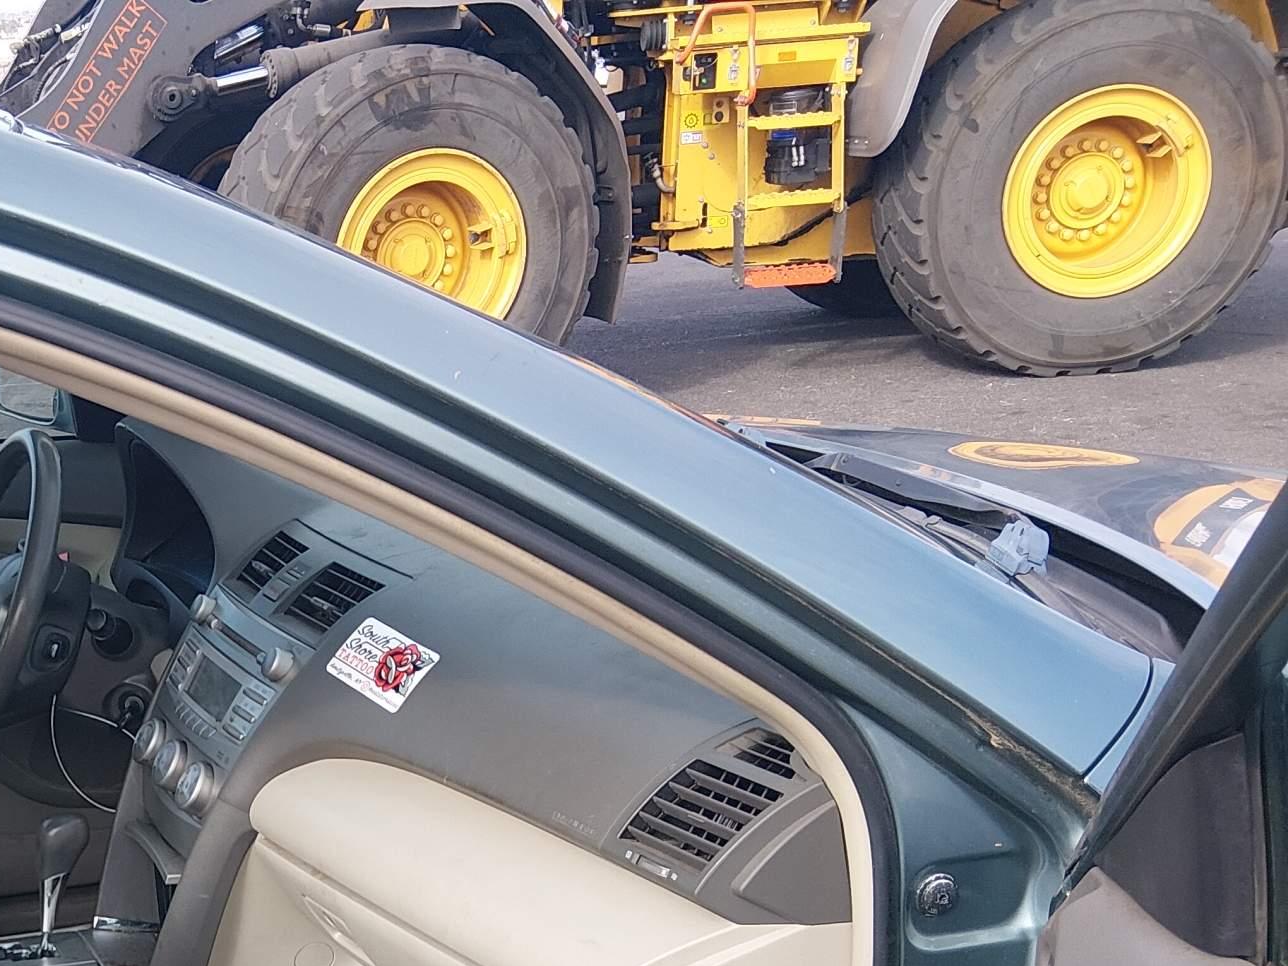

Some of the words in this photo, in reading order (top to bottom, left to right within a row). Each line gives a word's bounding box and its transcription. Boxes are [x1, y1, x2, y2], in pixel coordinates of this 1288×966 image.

[116, 20, 159, 79] MAST
[49, 111, 70, 132] O
[66, 60, 102, 111] NOT
[97, 0, 146, 59] WALK
[345, 638, 380, 663] Shore
[357, 624, 393, 652] South
[337, 648, 375, 675] TATTOO
